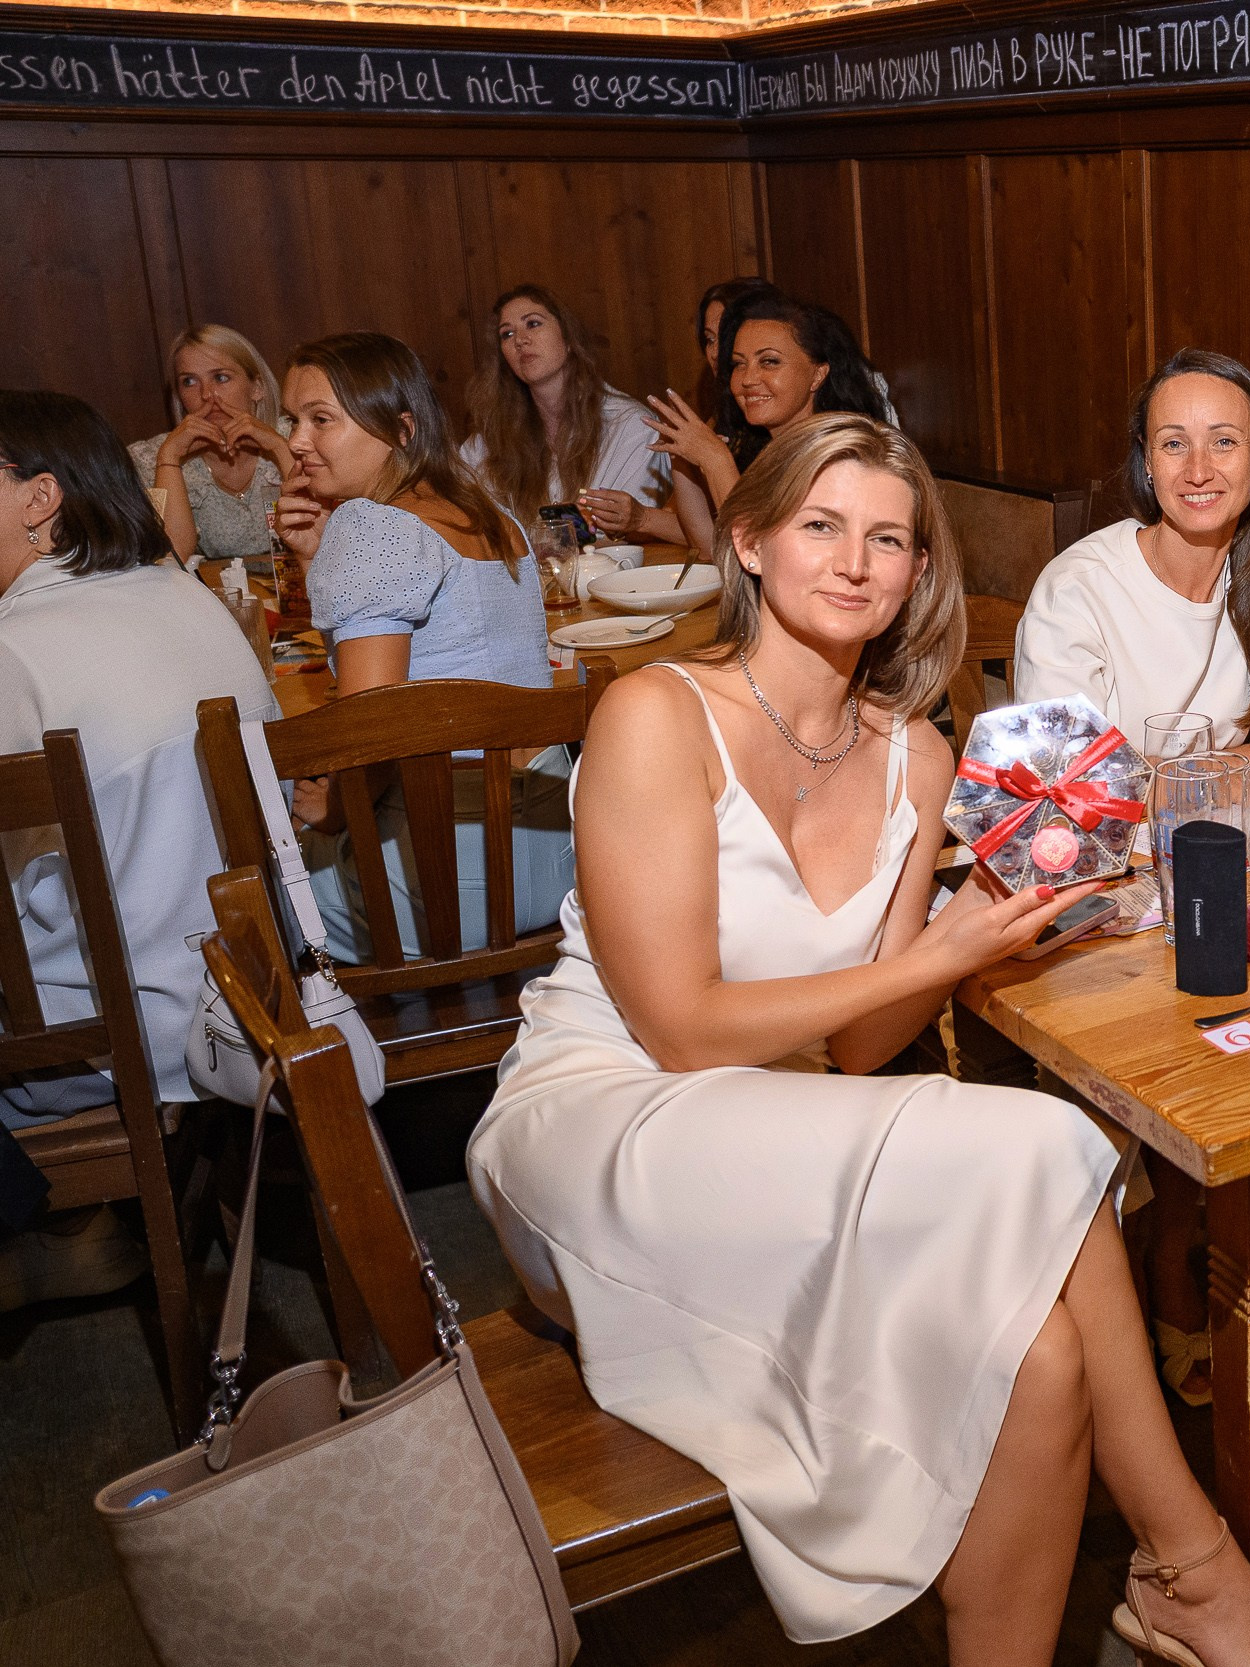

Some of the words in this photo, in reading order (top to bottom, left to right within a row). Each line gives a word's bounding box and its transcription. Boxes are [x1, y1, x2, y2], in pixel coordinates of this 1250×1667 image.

[0, 54, 99, 93] ssen
[280, 55, 347, 103] den
[466, 58, 552, 105] nicht
[572, 67, 734, 108] gegessen!
[804, 62, 828, 102] БЫ
[834, 52, 877, 102] АДАМ
[879, 49, 940, 99] КРУЖКУ
[950, 38, 1003, 90] ПИВА
[1011, 37, 1027, 82] В
